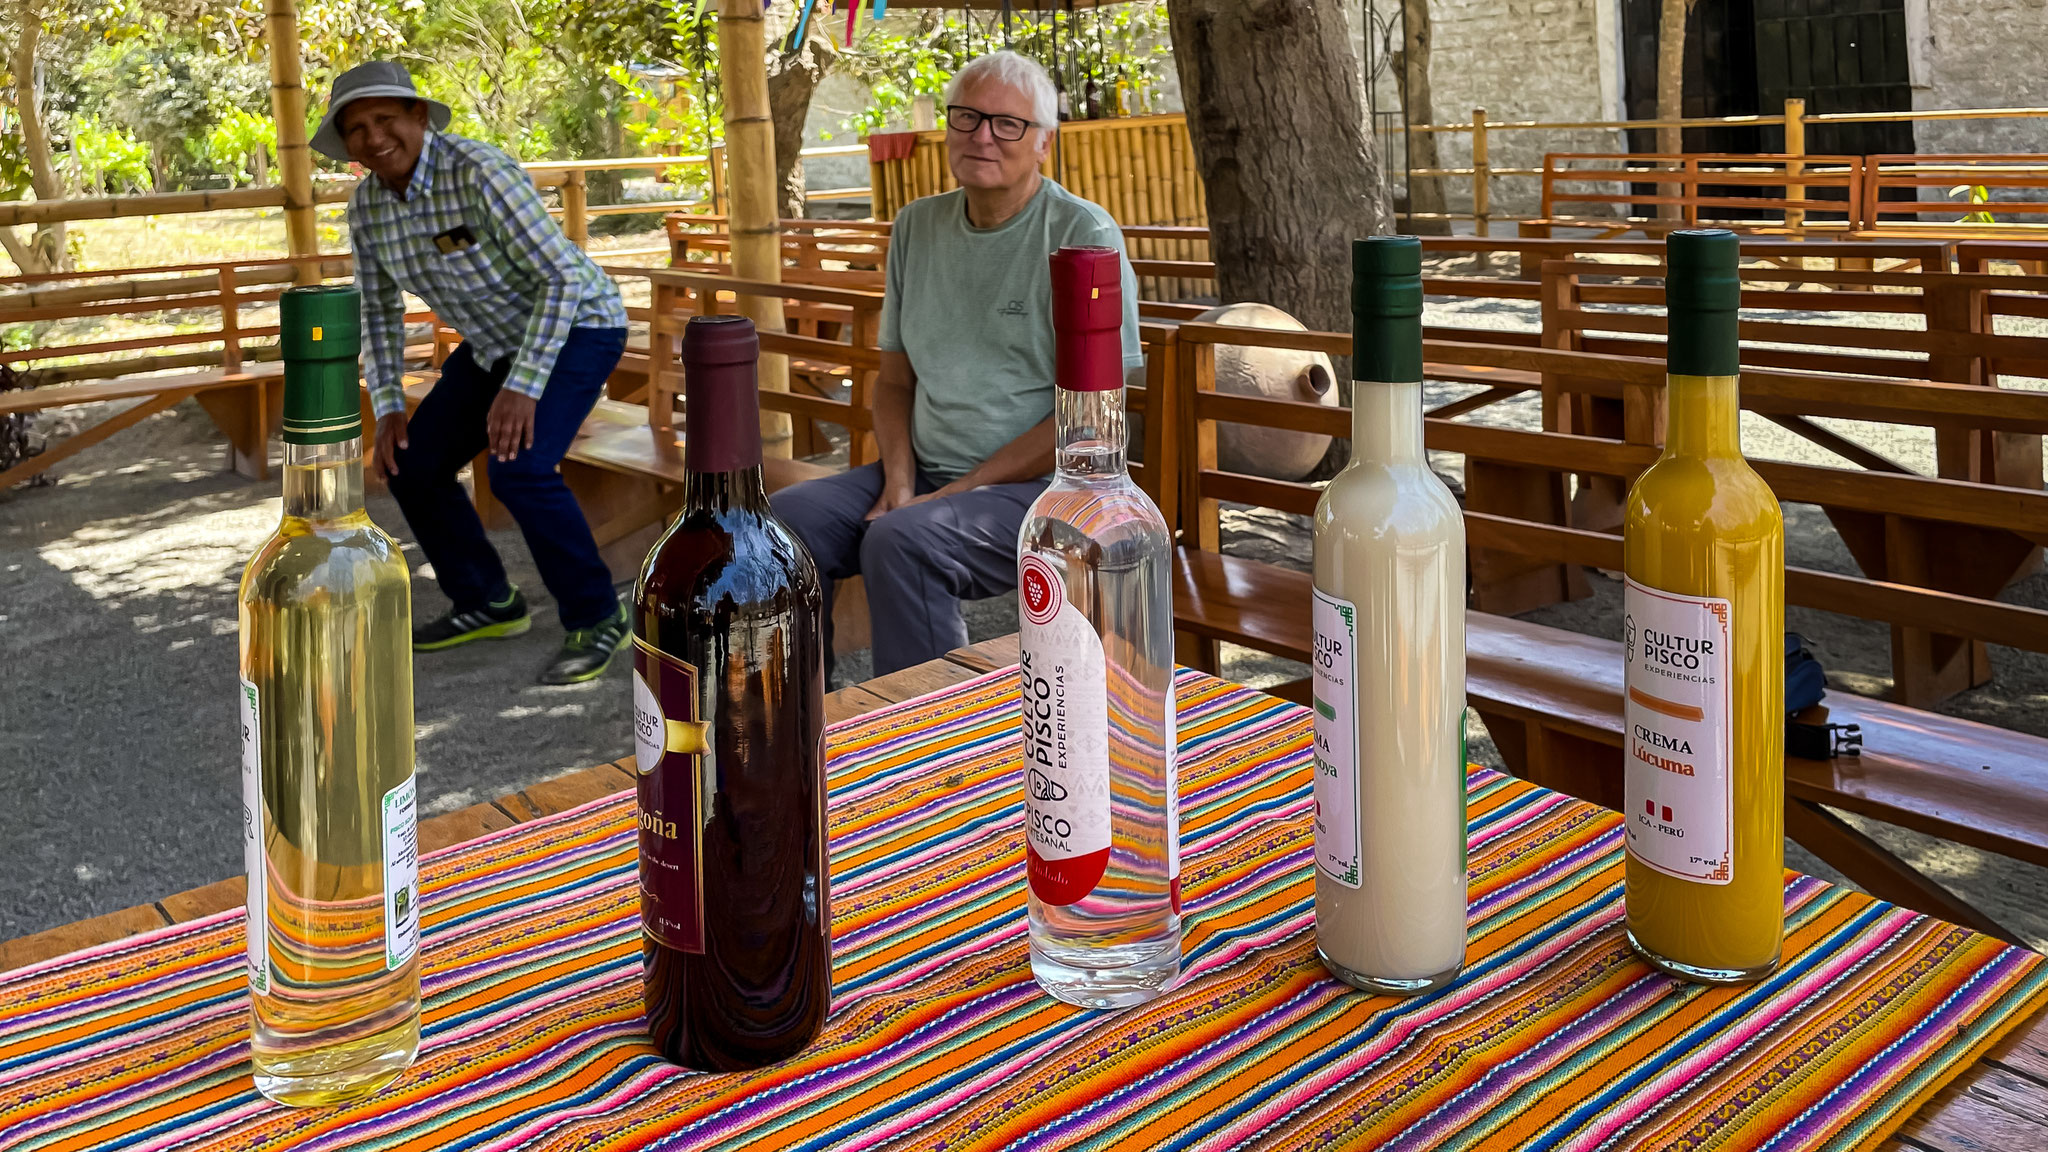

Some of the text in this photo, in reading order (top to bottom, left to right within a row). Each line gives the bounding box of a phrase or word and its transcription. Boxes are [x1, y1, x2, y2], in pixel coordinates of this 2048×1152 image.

[1644, 628, 1714, 655] CULTUR
[1644, 643, 1699, 670] PISCO
[1644, 663, 1716, 685] EXPERIENCIAS
[1022, 649, 1035, 759] CULTUR
[1055, 665, 1067, 769] EXPERIENCIAS
[1033, 677, 1053, 768] PISCO
[1634, 724, 1694, 755] CREMA
[1632, 736, 1696, 777] Lúcuma
[639, 806, 678, 840] goña
[1027, 802, 1071, 839] PISCO
[1638, 813, 1652, 828] ICA
[1658, 823, 1685, 838] PERÚ
[1029, 825, 1072, 853] TESANAL
[1703, 859, 1719, 867] vol.
